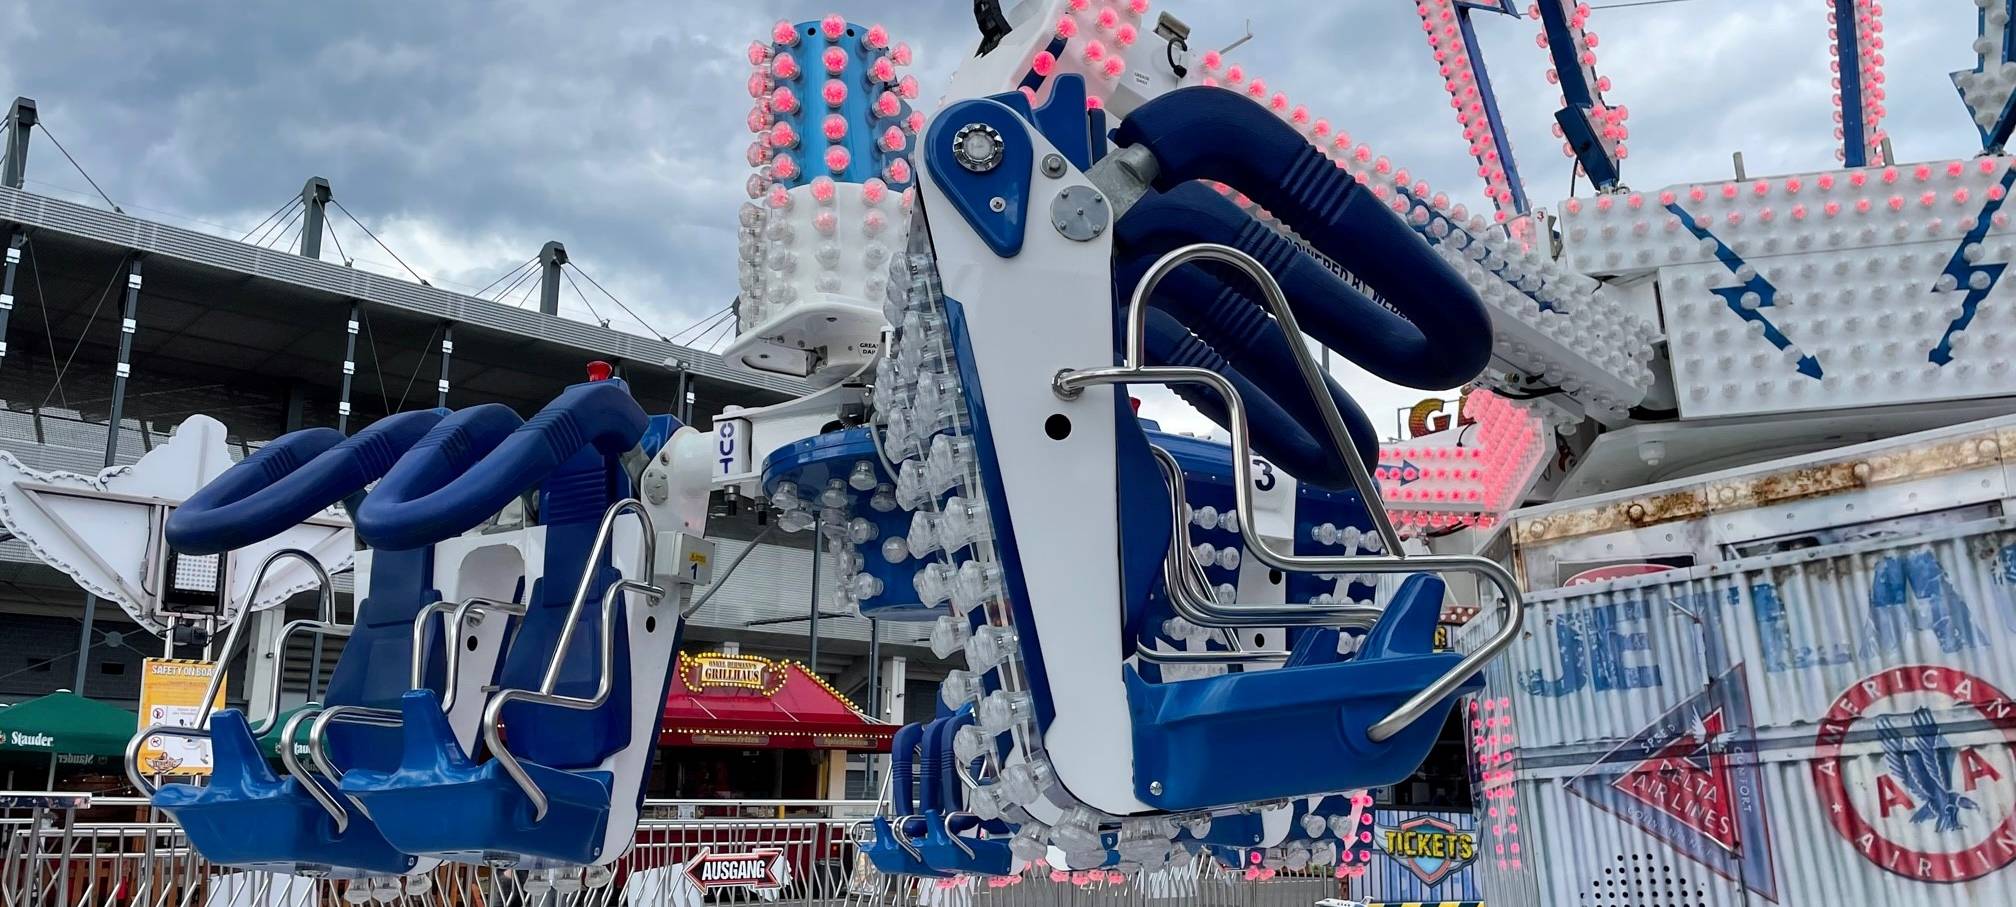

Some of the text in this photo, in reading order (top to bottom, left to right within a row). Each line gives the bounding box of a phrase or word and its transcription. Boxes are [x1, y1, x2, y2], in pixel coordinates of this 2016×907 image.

[719, 422, 735, 474] OUT
[1252, 459, 1276, 492] 3
[691, 562, 698, 580] 1
[1752, 543, 2016, 673] LA
[151, 664, 182, 676] SAFETY
[183, 667, 195, 676] ON
[704, 668, 760, 682] GRILLHAUS
[11, 731, 54, 747] Stauder
[1817, 668, 2012, 777] AMERICAN
[1657, 758, 1718, 804] DELTA
[1876, 747, 2003, 819] A A
[1632, 773, 1731, 835] AIR LINES
[1384, 830, 1474, 860] TICKETS
[1855, 829, 2016, 878] AIRLIN
[701, 860, 766, 881] AUSGANG
